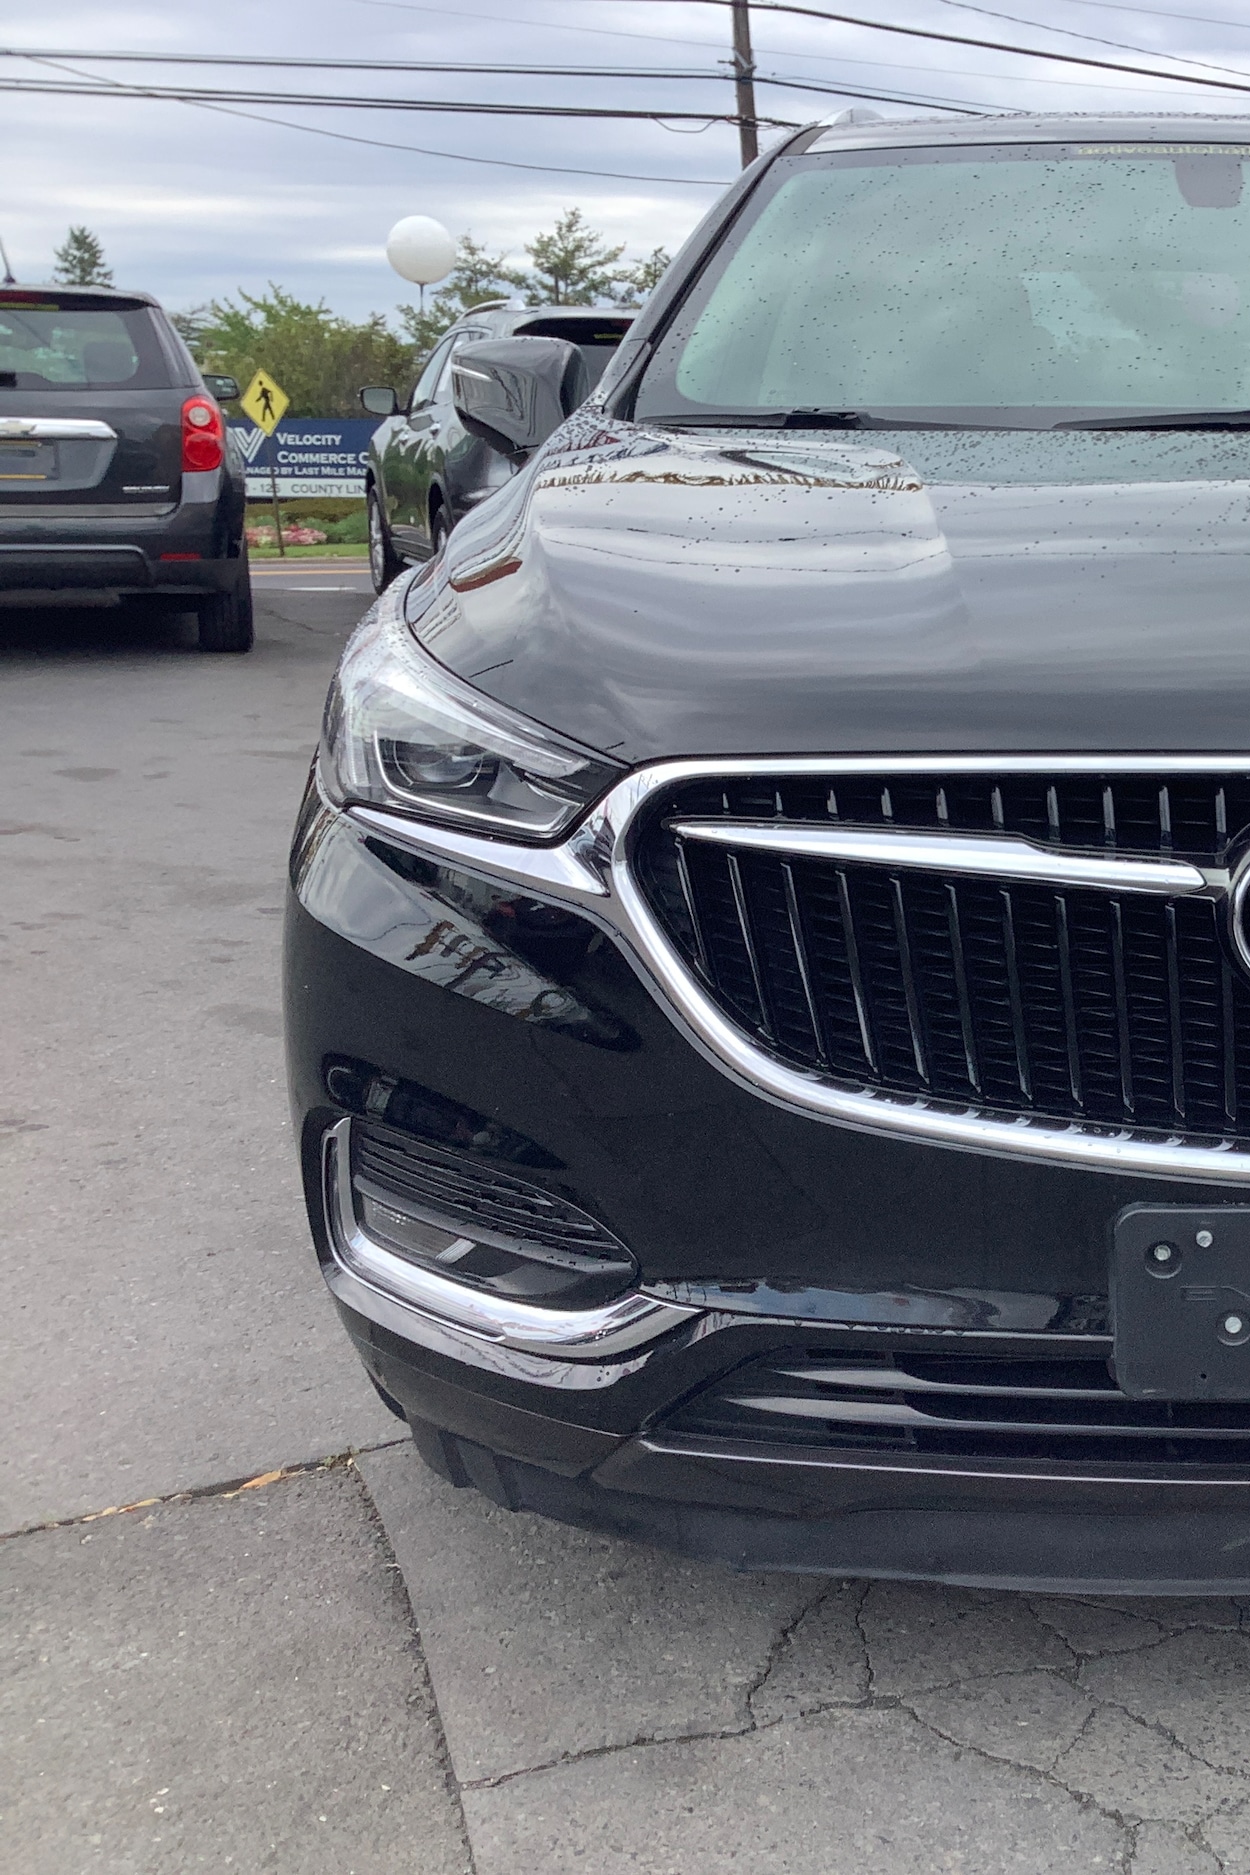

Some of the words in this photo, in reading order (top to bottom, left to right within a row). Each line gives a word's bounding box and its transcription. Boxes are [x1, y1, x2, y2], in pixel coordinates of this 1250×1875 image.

[276, 432, 342, 445] VELOCITY
[277, 451, 356, 464] COMMERCE
[294, 465, 319, 476] LAST
[320, 465, 346, 476] MILE
[290, 483, 344, 494] COUNTY
